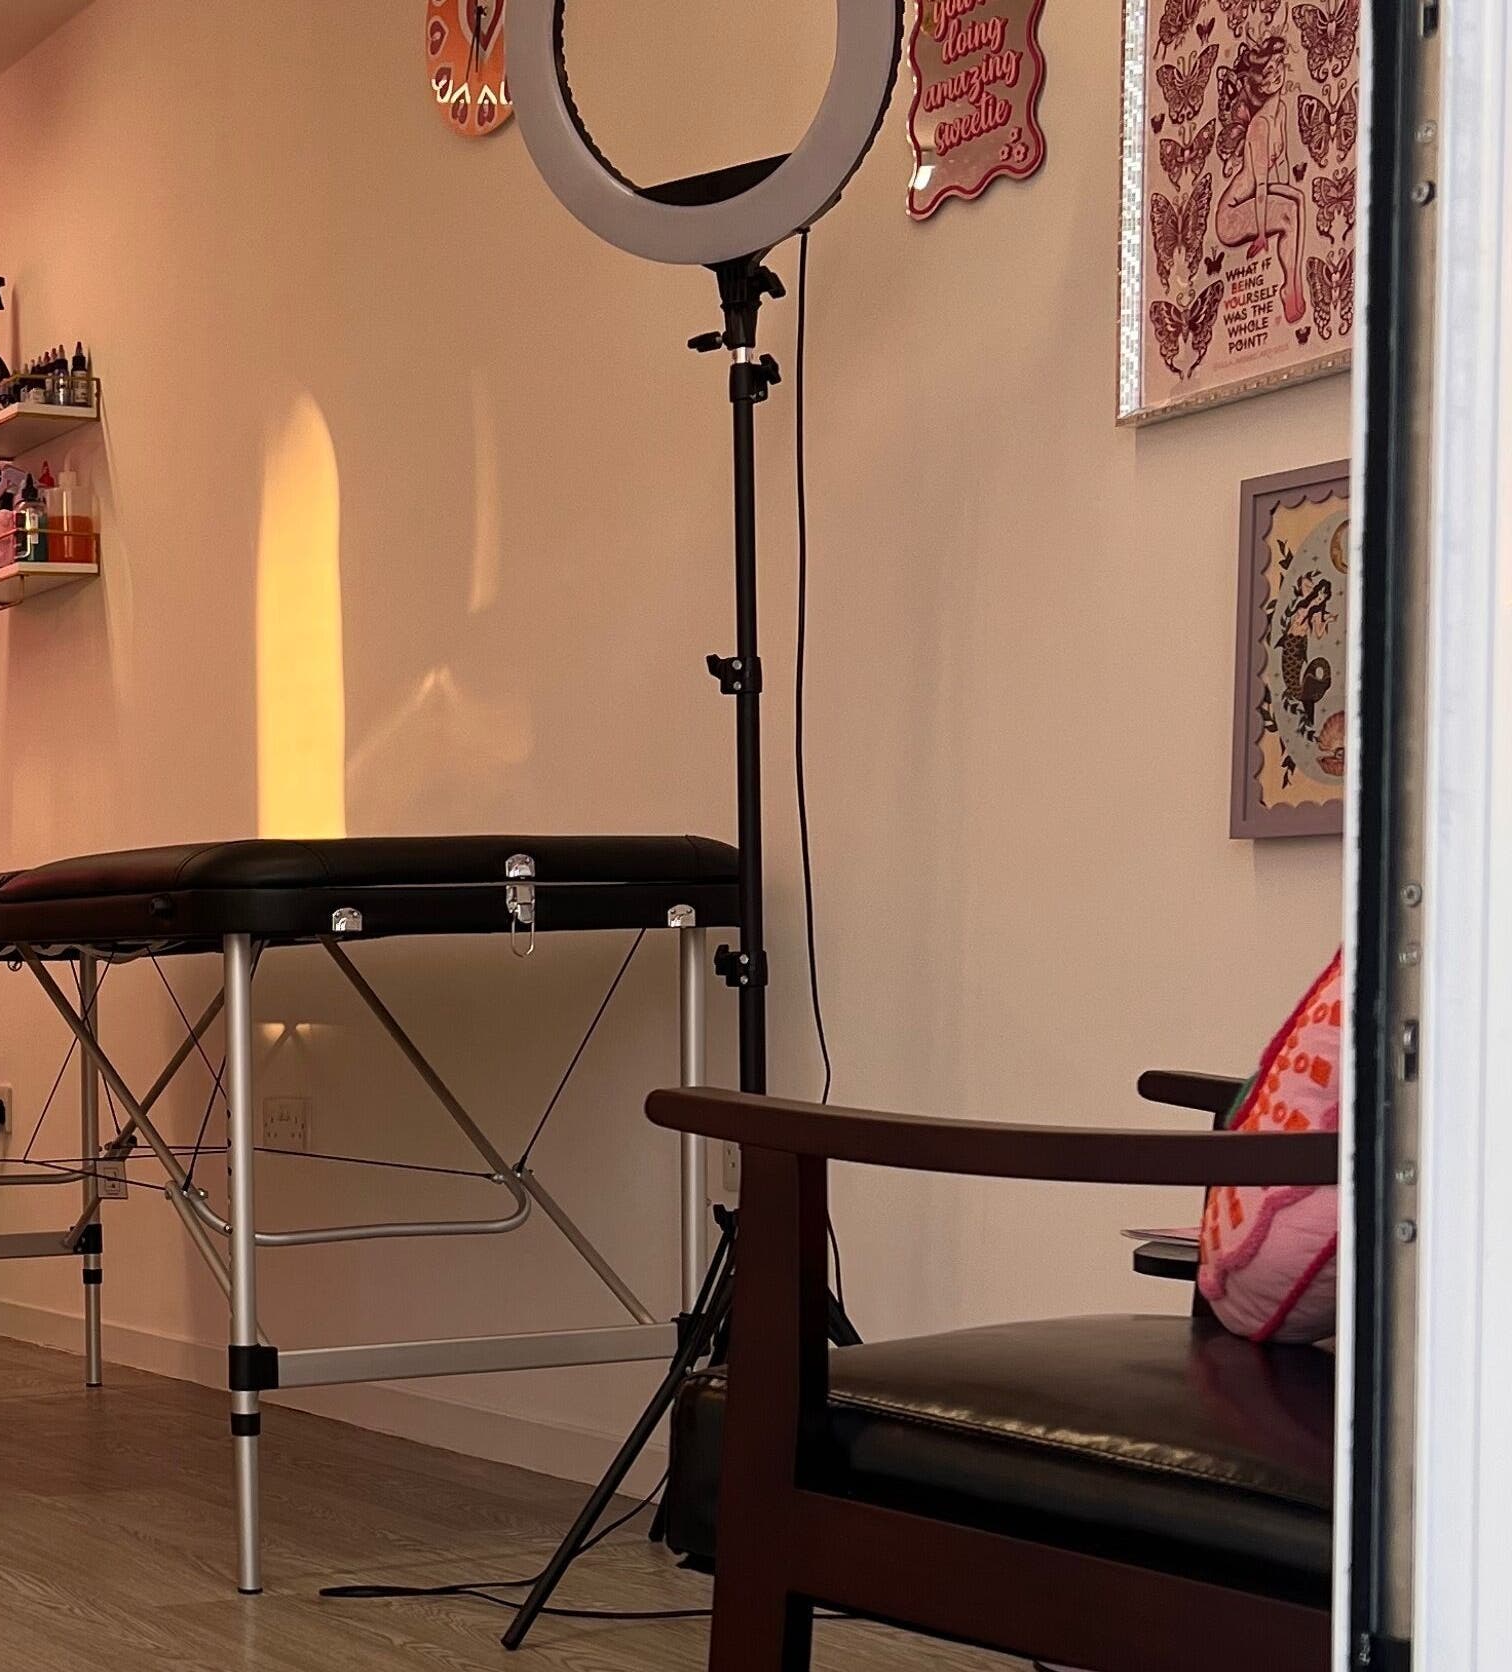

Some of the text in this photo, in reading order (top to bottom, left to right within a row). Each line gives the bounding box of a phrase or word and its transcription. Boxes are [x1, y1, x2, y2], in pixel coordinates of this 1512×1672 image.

[942, 16, 1008, 64] doing
[923, 49, 1023, 112] amazing
[934, 92, 1012, 156] sweetie
[1225, 257, 1272, 282] WHAT IF
[1224, 284, 1279, 310] YOURSELF
[1231, 275, 1264, 294] BEING
[1223, 303, 1273, 326] WAS THE
[1228, 317, 1269, 338] WHOLE
[1228, 333, 1268, 354] POINT?
